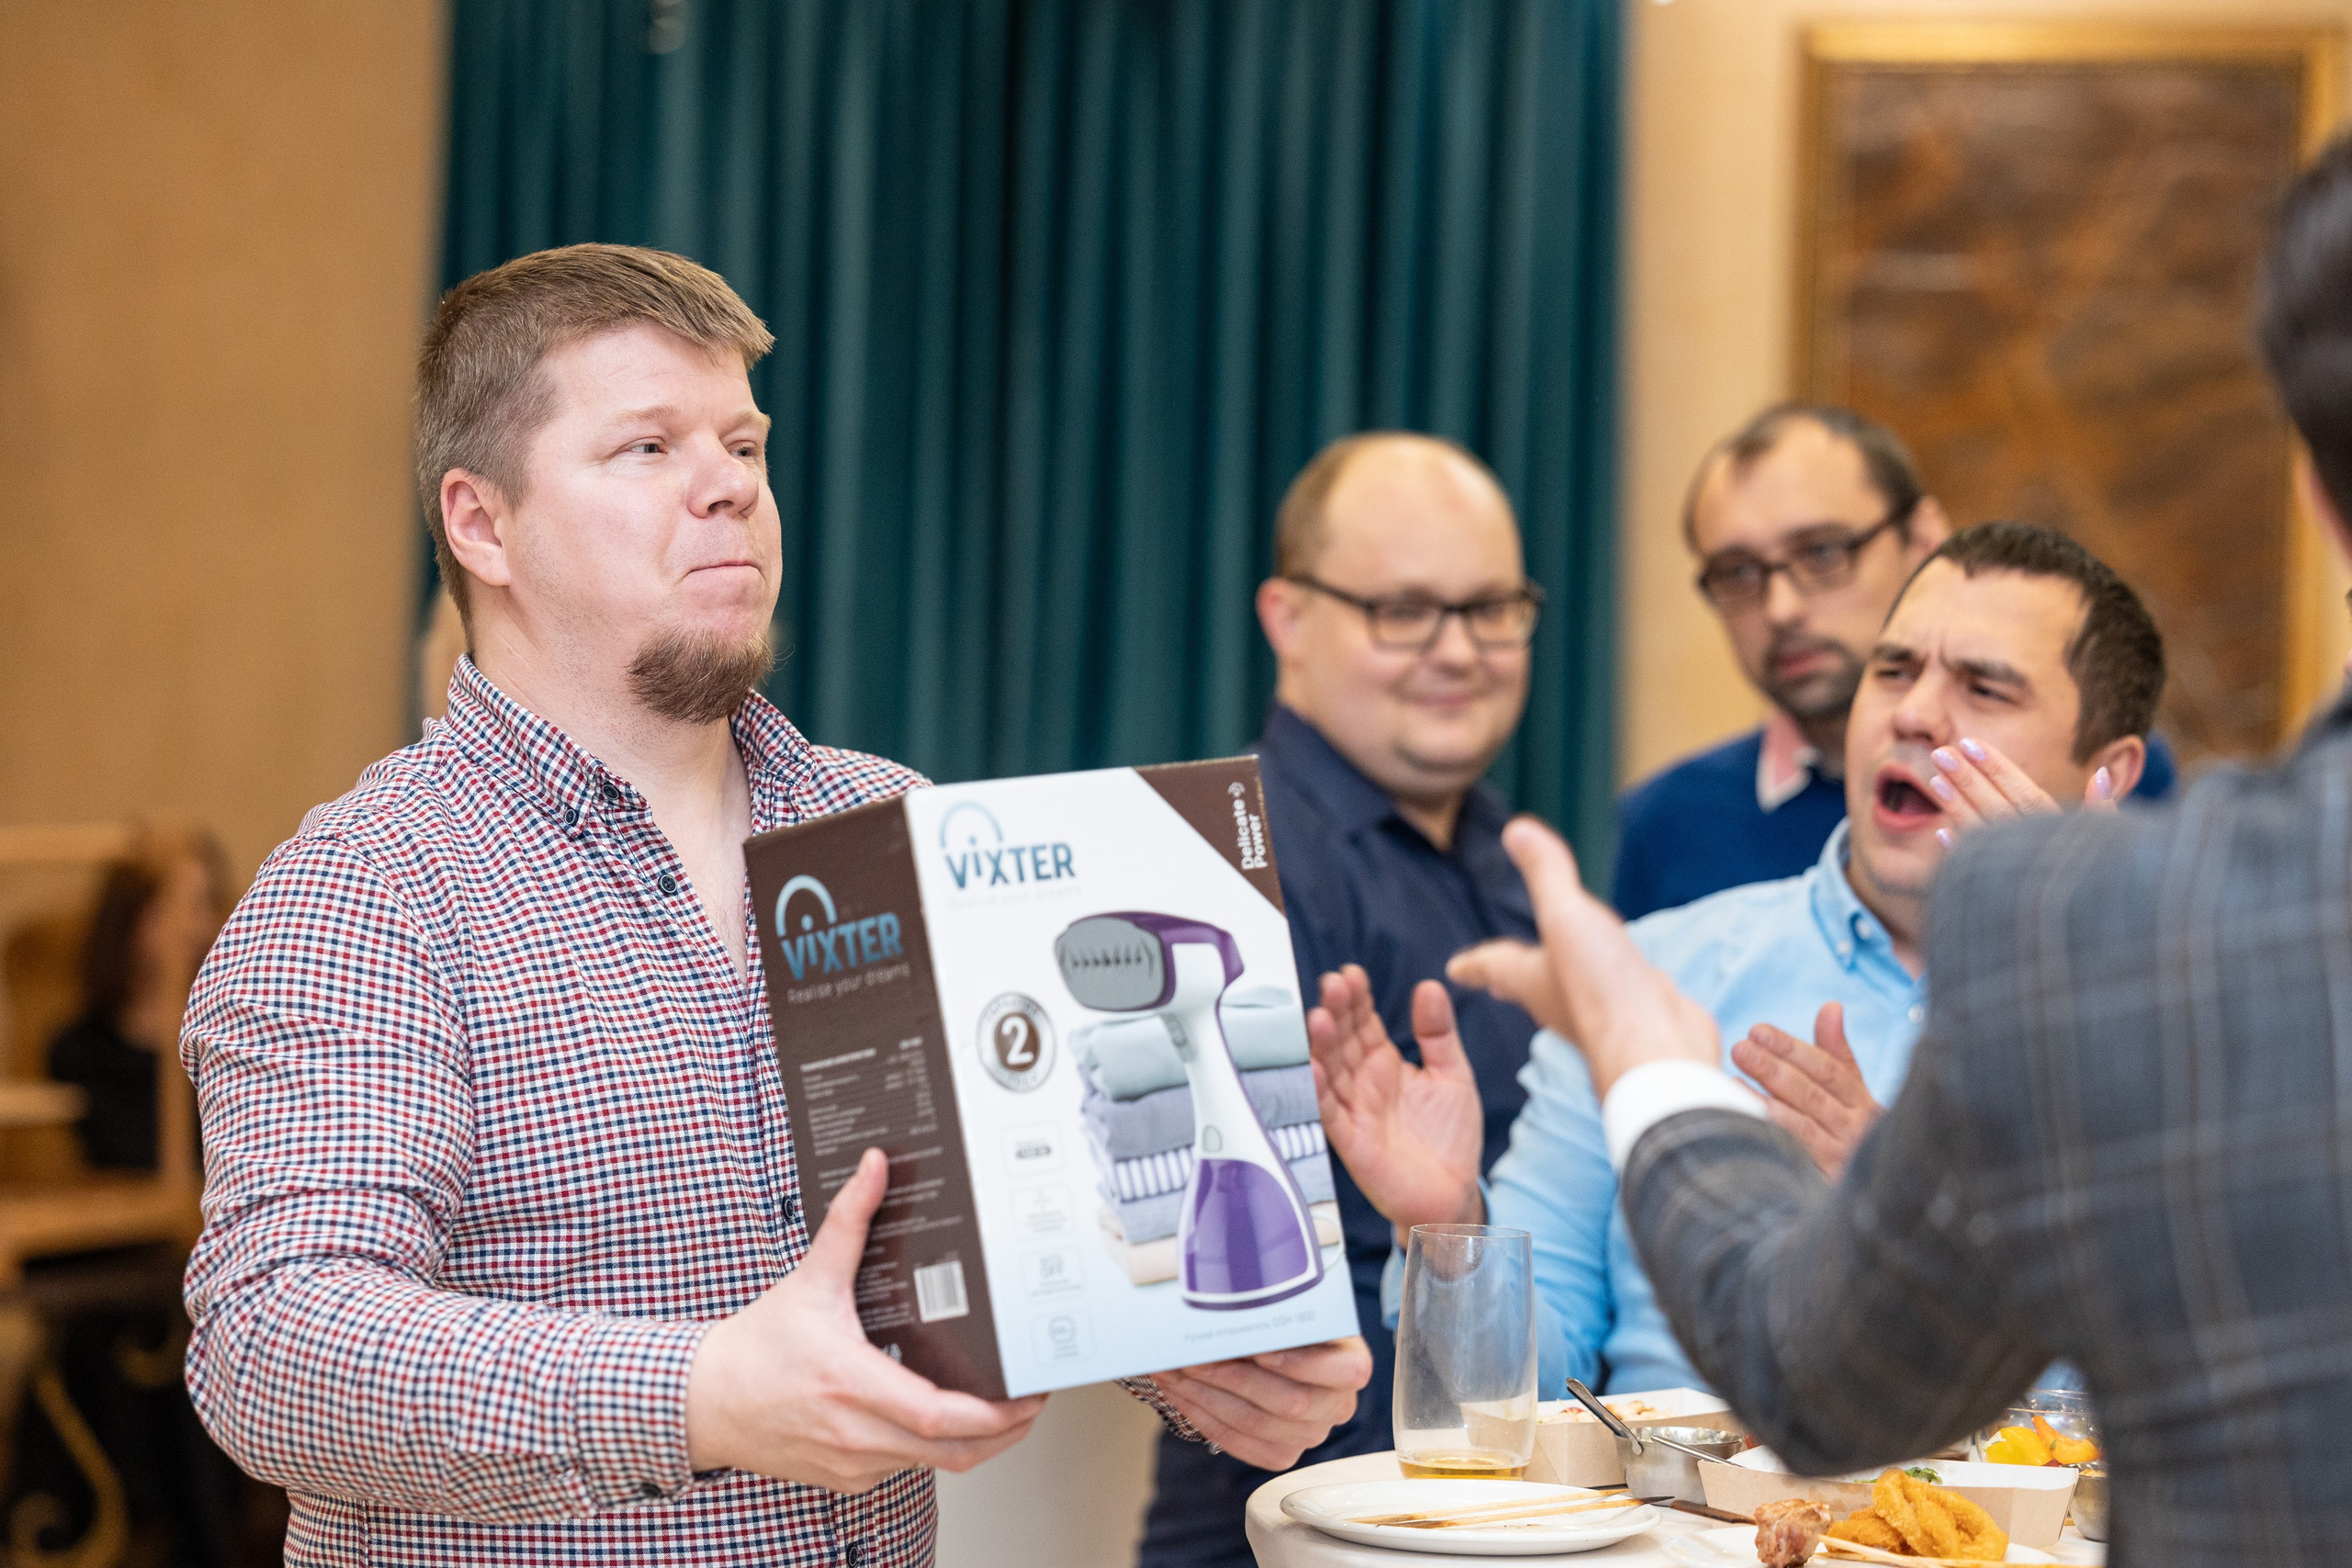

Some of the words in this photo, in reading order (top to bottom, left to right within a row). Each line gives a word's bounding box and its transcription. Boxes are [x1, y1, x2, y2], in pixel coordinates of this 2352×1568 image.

[1233, 799, 1255, 870] Delicate
[1249, 813, 1268, 869] Power
[834, 975, 863, 998] your
[1001, 1016, 1035, 1066] 2
